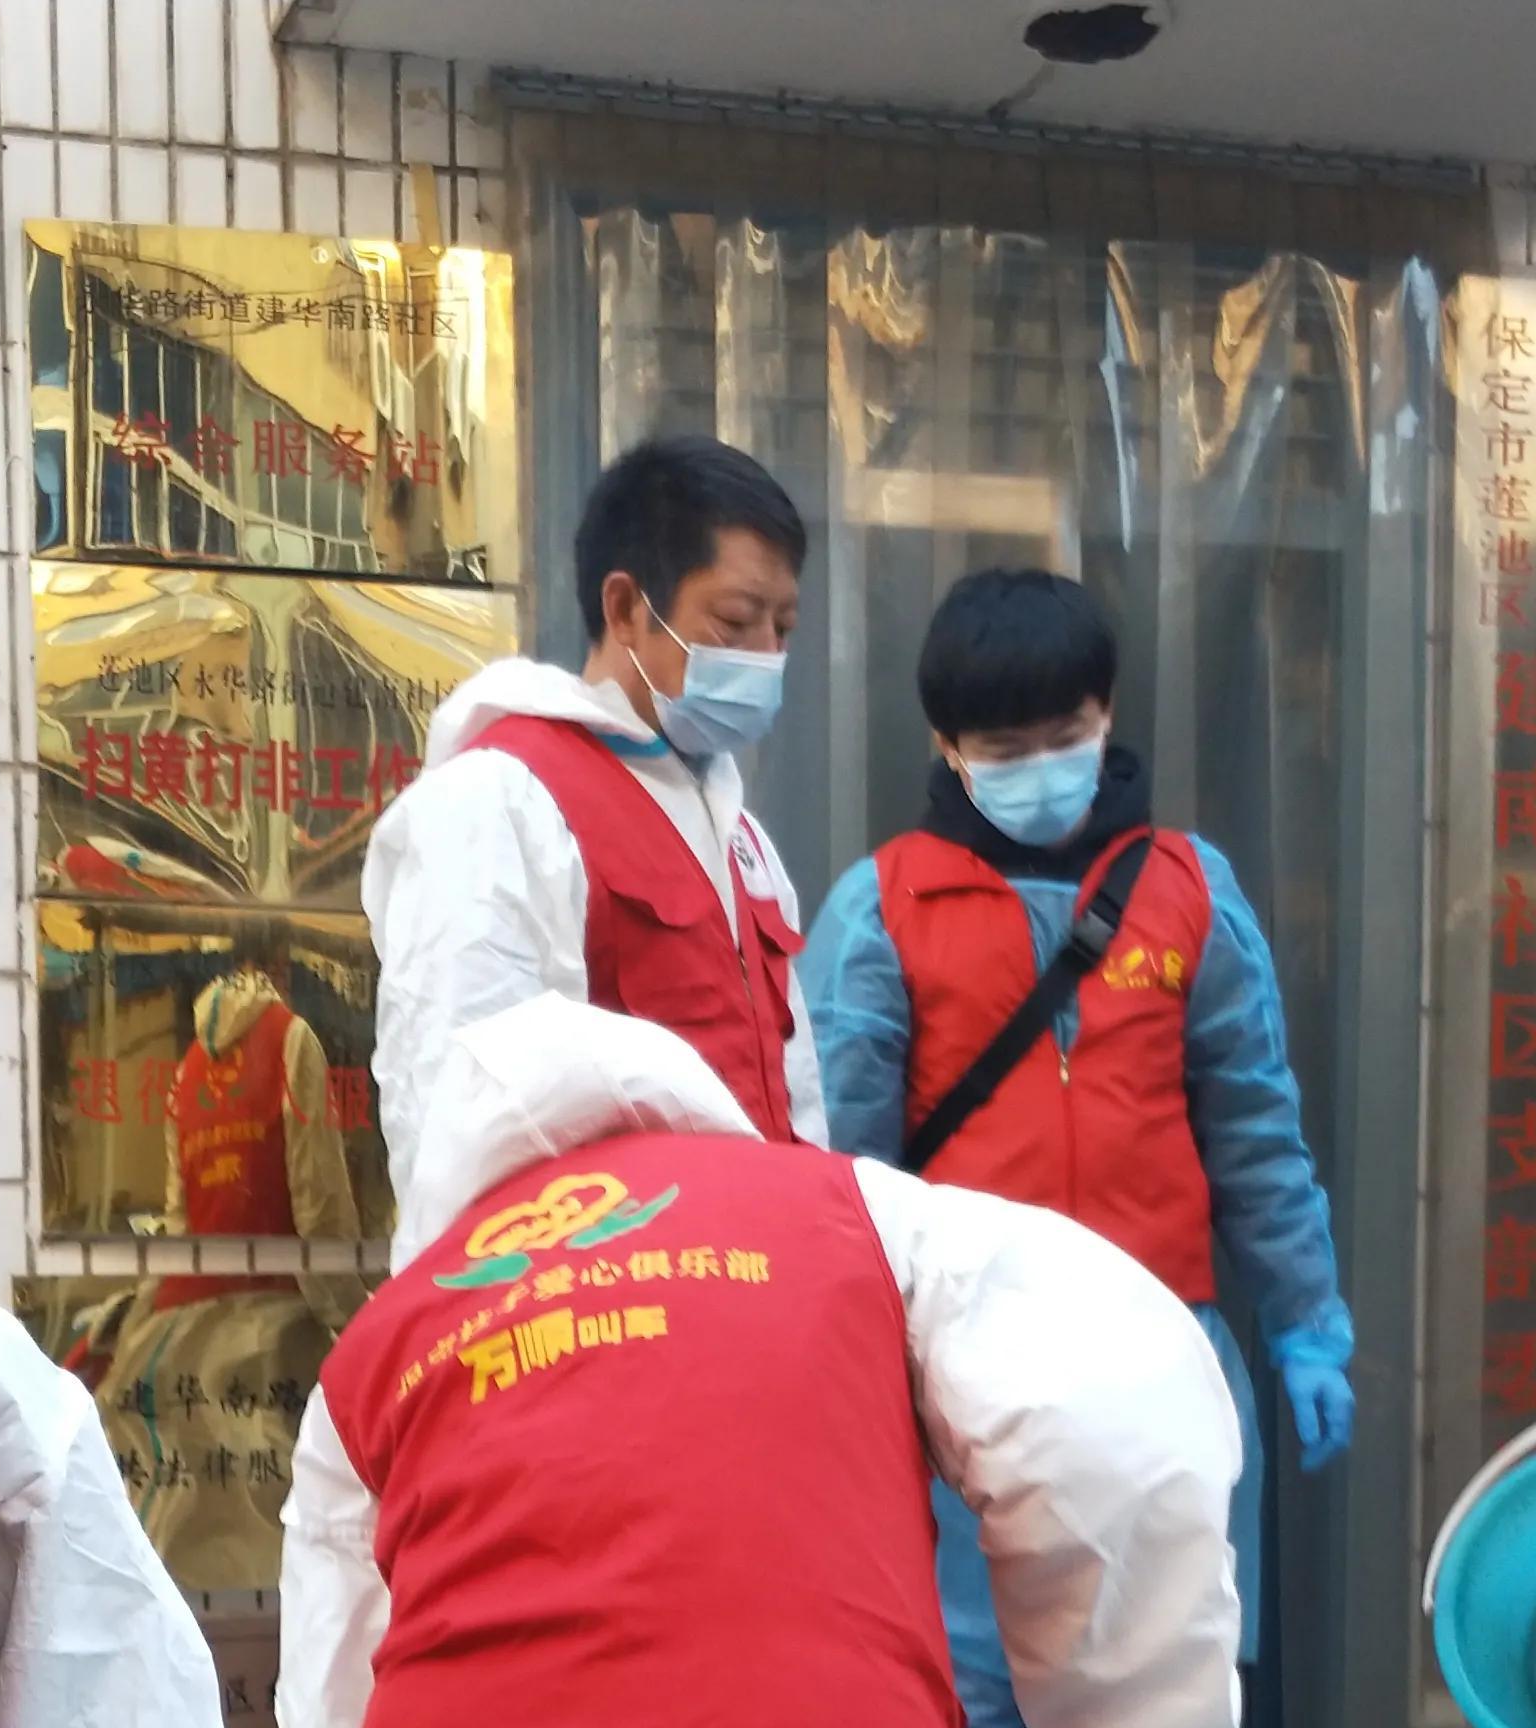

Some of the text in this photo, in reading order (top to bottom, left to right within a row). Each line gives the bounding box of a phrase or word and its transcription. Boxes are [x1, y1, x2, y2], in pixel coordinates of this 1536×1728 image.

[112, 411, 443, 487] 综合服务站
[1478, 312, 1534, 628] 保定市莲池区
[456, 1305, 668, 1404] 万顺叫车
